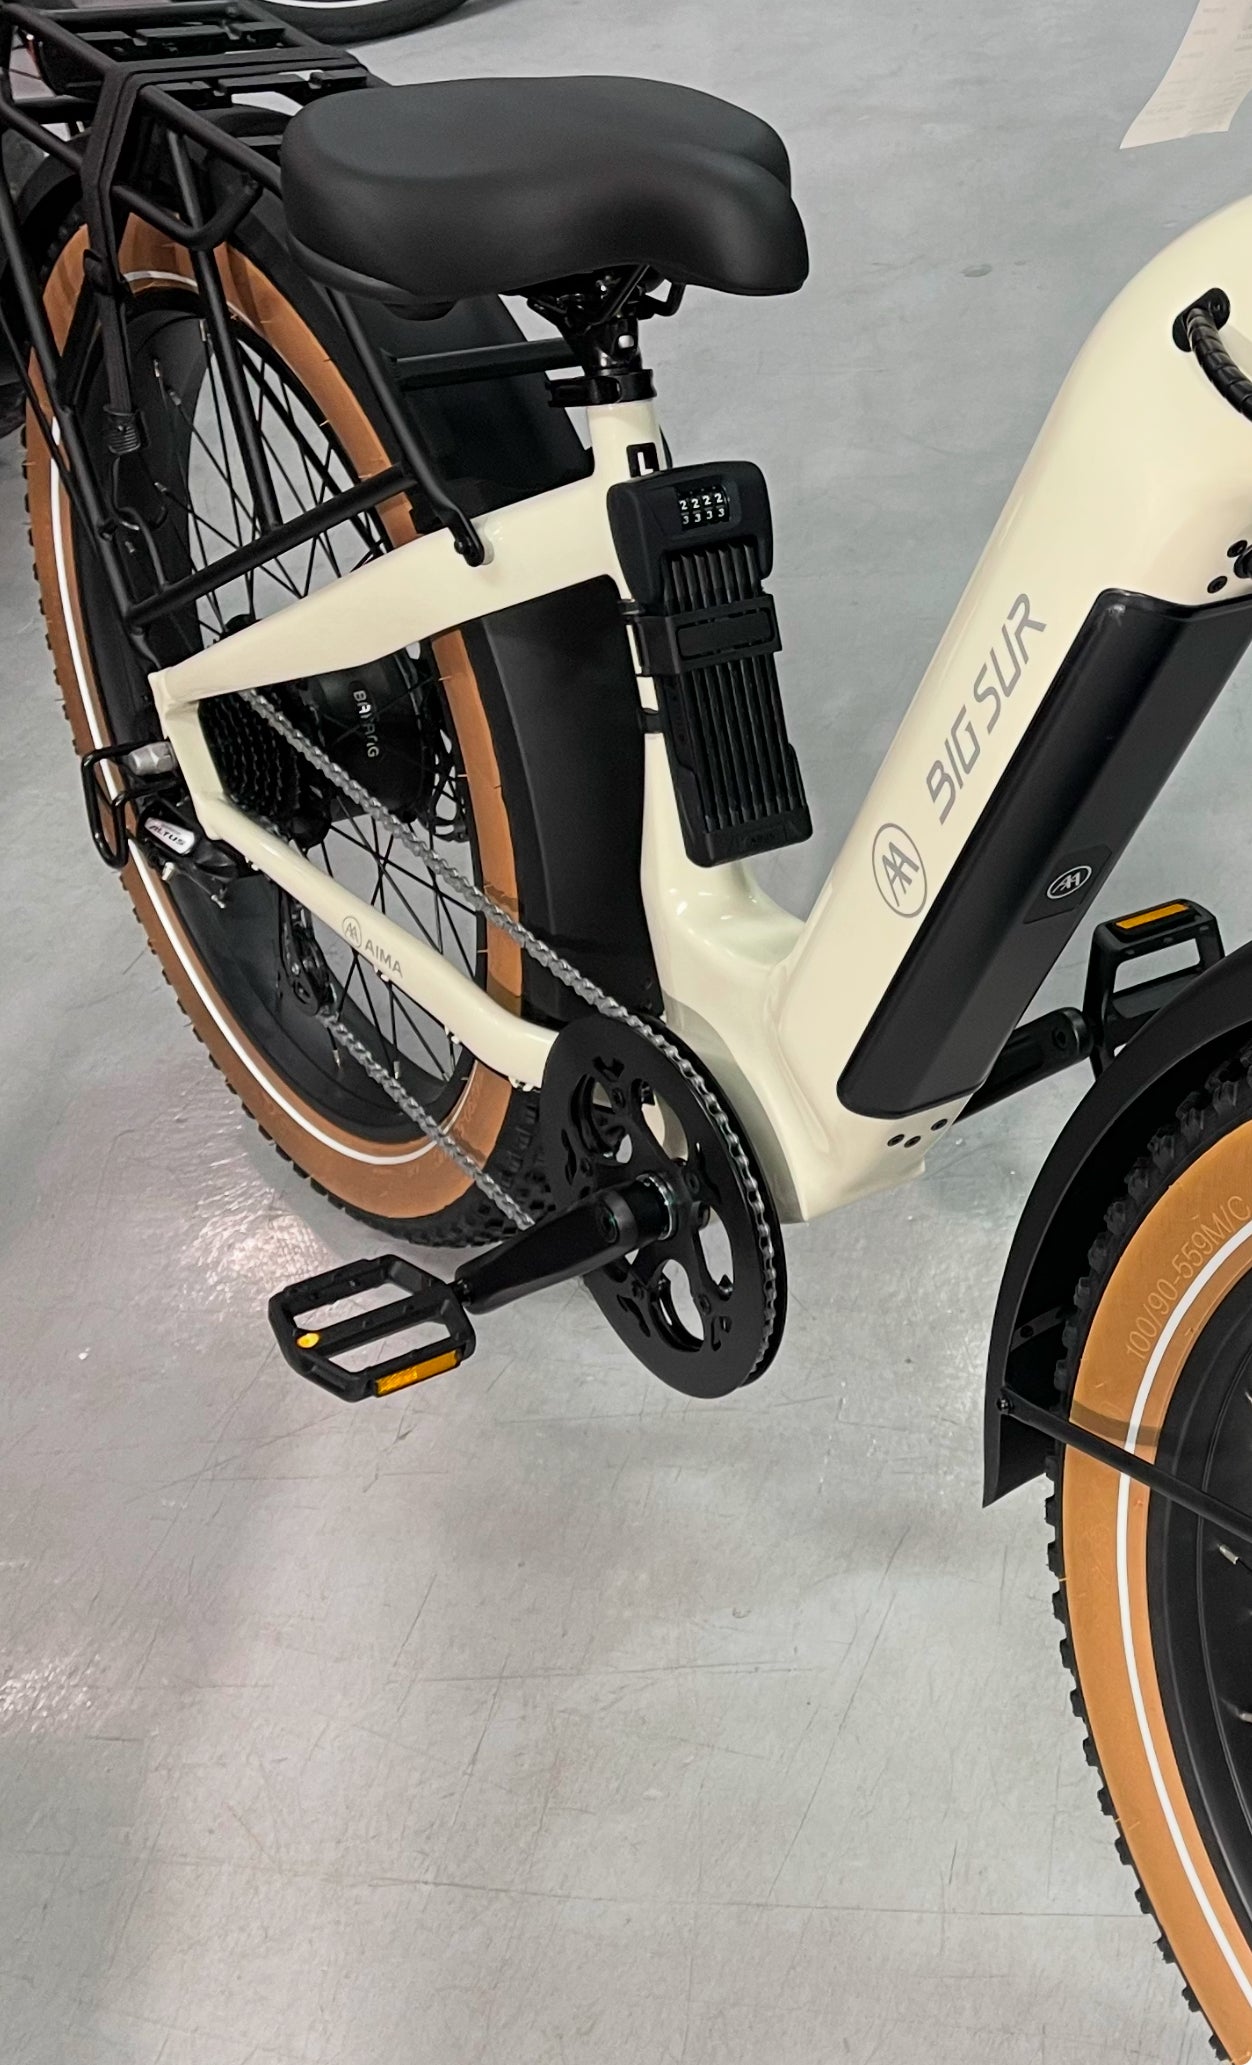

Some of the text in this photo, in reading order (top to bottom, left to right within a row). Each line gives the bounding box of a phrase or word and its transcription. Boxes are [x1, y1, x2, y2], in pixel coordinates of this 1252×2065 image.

[637, 451, 654, 477] L
[926, 593, 1047, 826] BIG SUR
[365, 939, 403, 979] AIMA
